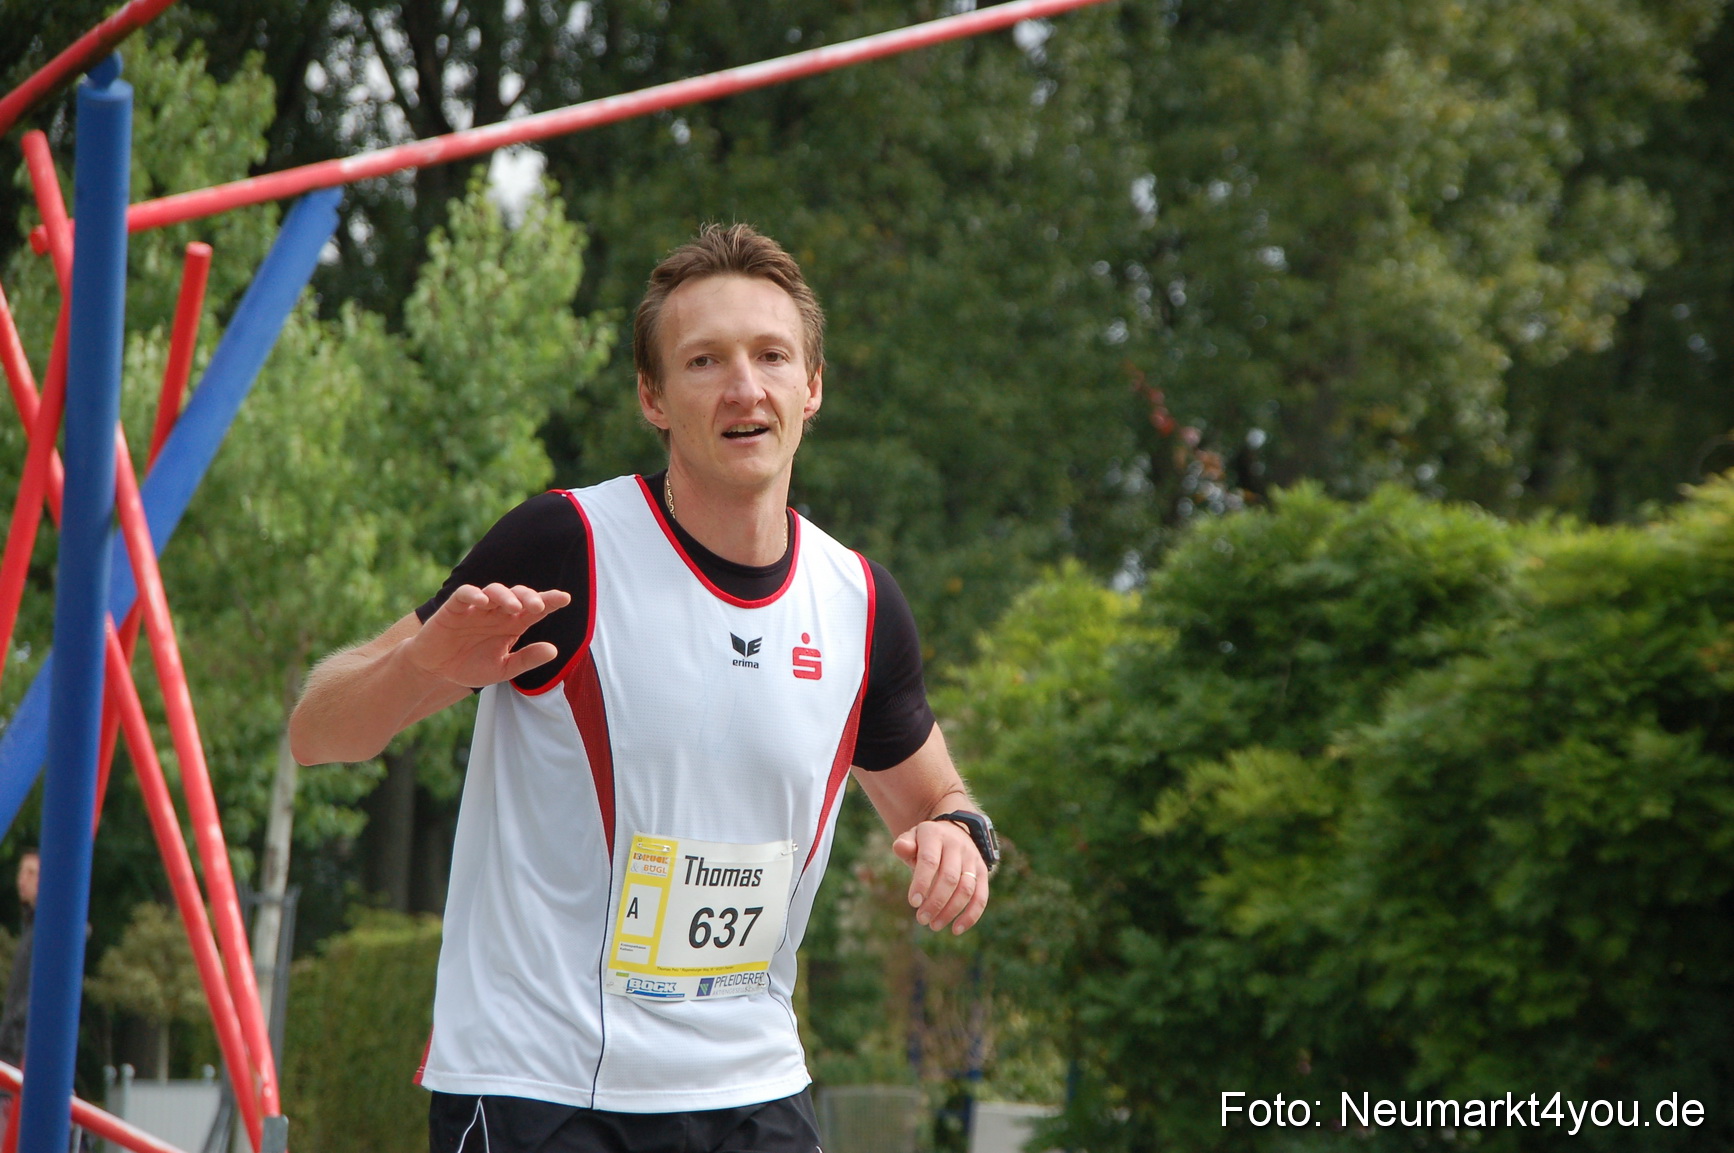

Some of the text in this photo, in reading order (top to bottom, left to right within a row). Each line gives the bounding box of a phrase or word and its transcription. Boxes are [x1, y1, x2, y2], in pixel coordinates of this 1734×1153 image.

[732, 659, 759, 669] erima
[684, 855, 763, 887] Thomas
[626, 896, 639, 919] A
[688, 906, 764, 949] 637
[627, 978, 677, 993] BOCK
